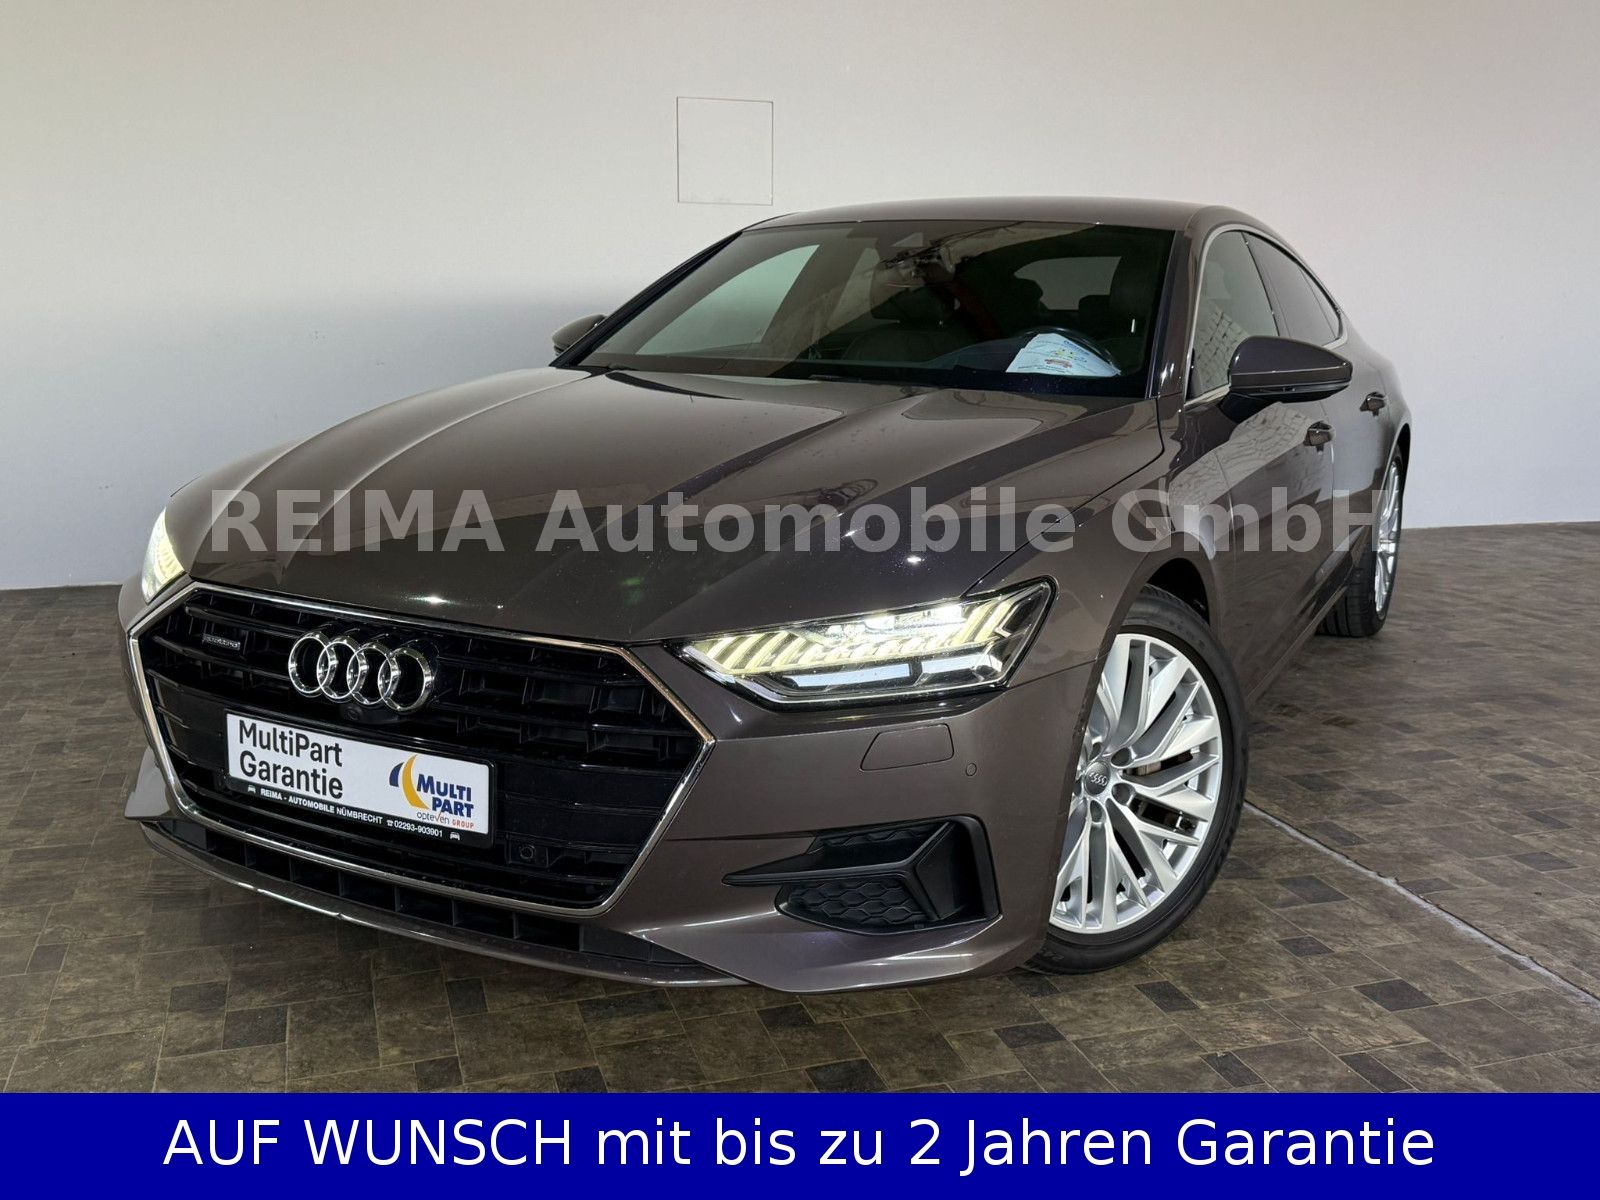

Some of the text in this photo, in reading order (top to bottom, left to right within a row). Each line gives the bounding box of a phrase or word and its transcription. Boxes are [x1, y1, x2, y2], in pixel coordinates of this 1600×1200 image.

[239, 719, 343, 767] MultiPart
[239, 750, 344, 799] Garantie
[416, 773, 472, 802] MULTI
[260, 788, 283, 801] REIMA
[288, 795, 336, 814] AUTOMOBILE
[336, 807, 384, 825] NÜMBRECHT
[394, 820, 443, 837] 02293-903901
[416, 811, 475, 829] opteven GROUP
[431, 797, 475, 818] PART
